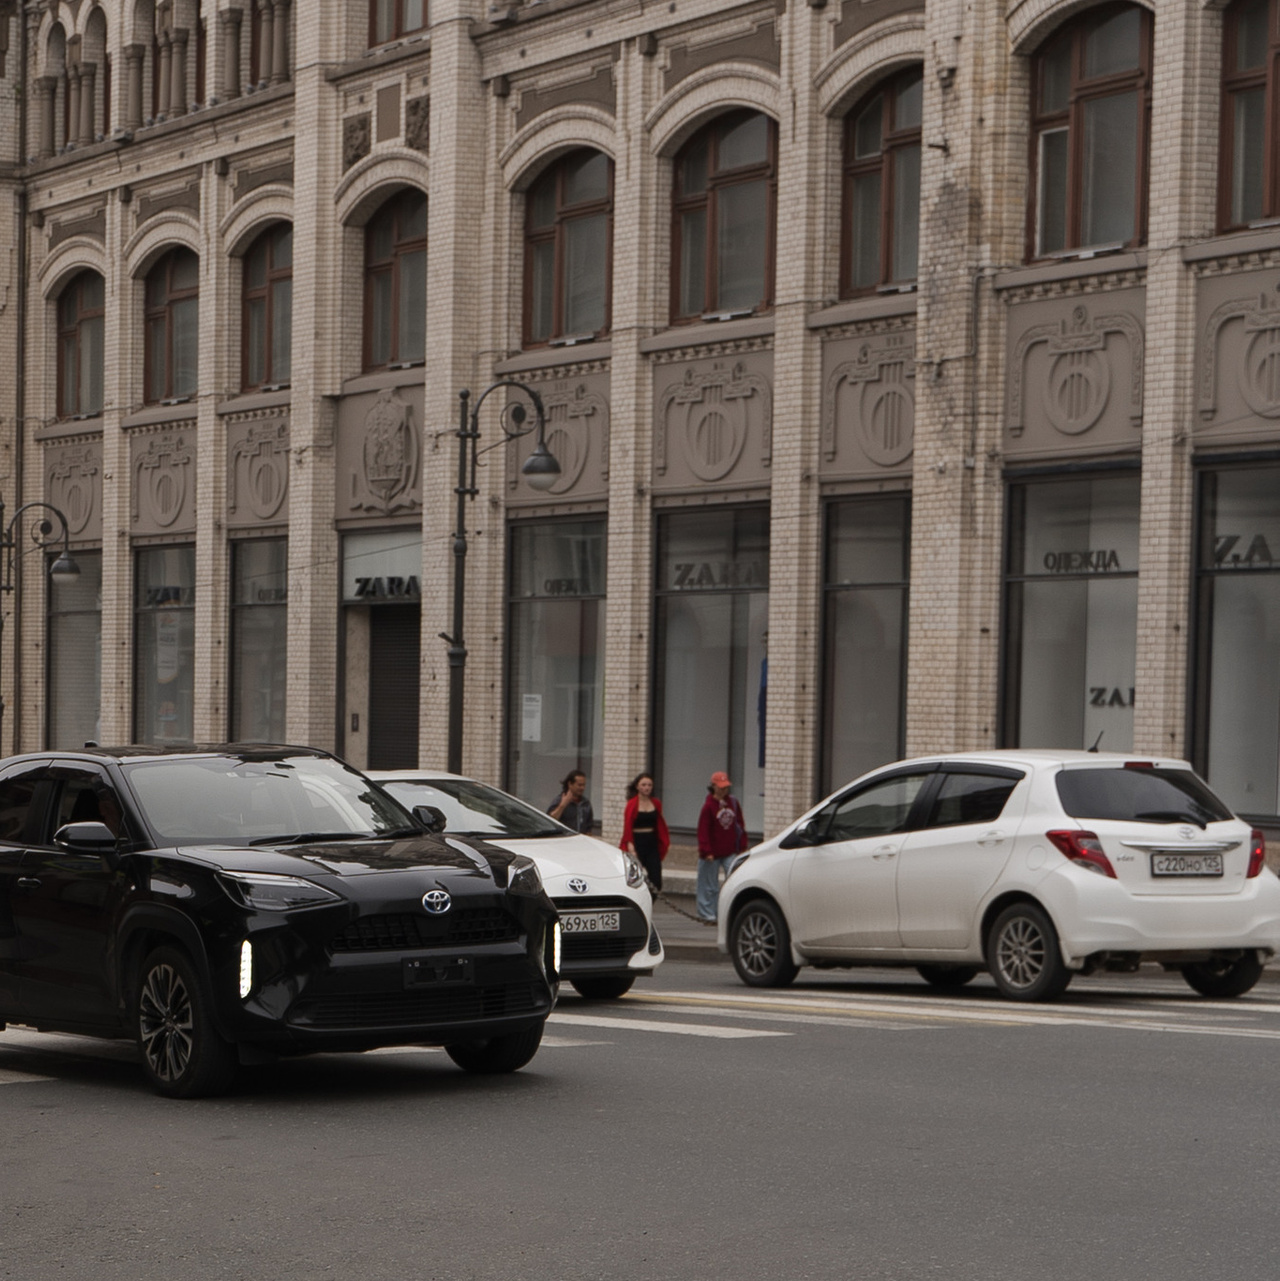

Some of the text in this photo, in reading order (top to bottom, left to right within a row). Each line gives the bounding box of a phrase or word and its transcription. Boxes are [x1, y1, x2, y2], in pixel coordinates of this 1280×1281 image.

[1043, 550, 1120, 571] ОДЕЖДА
[354, 575, 421, 597] ZARA
[1203, 857, 1219, 867] 125
[599, 914, 617, 926] 125
